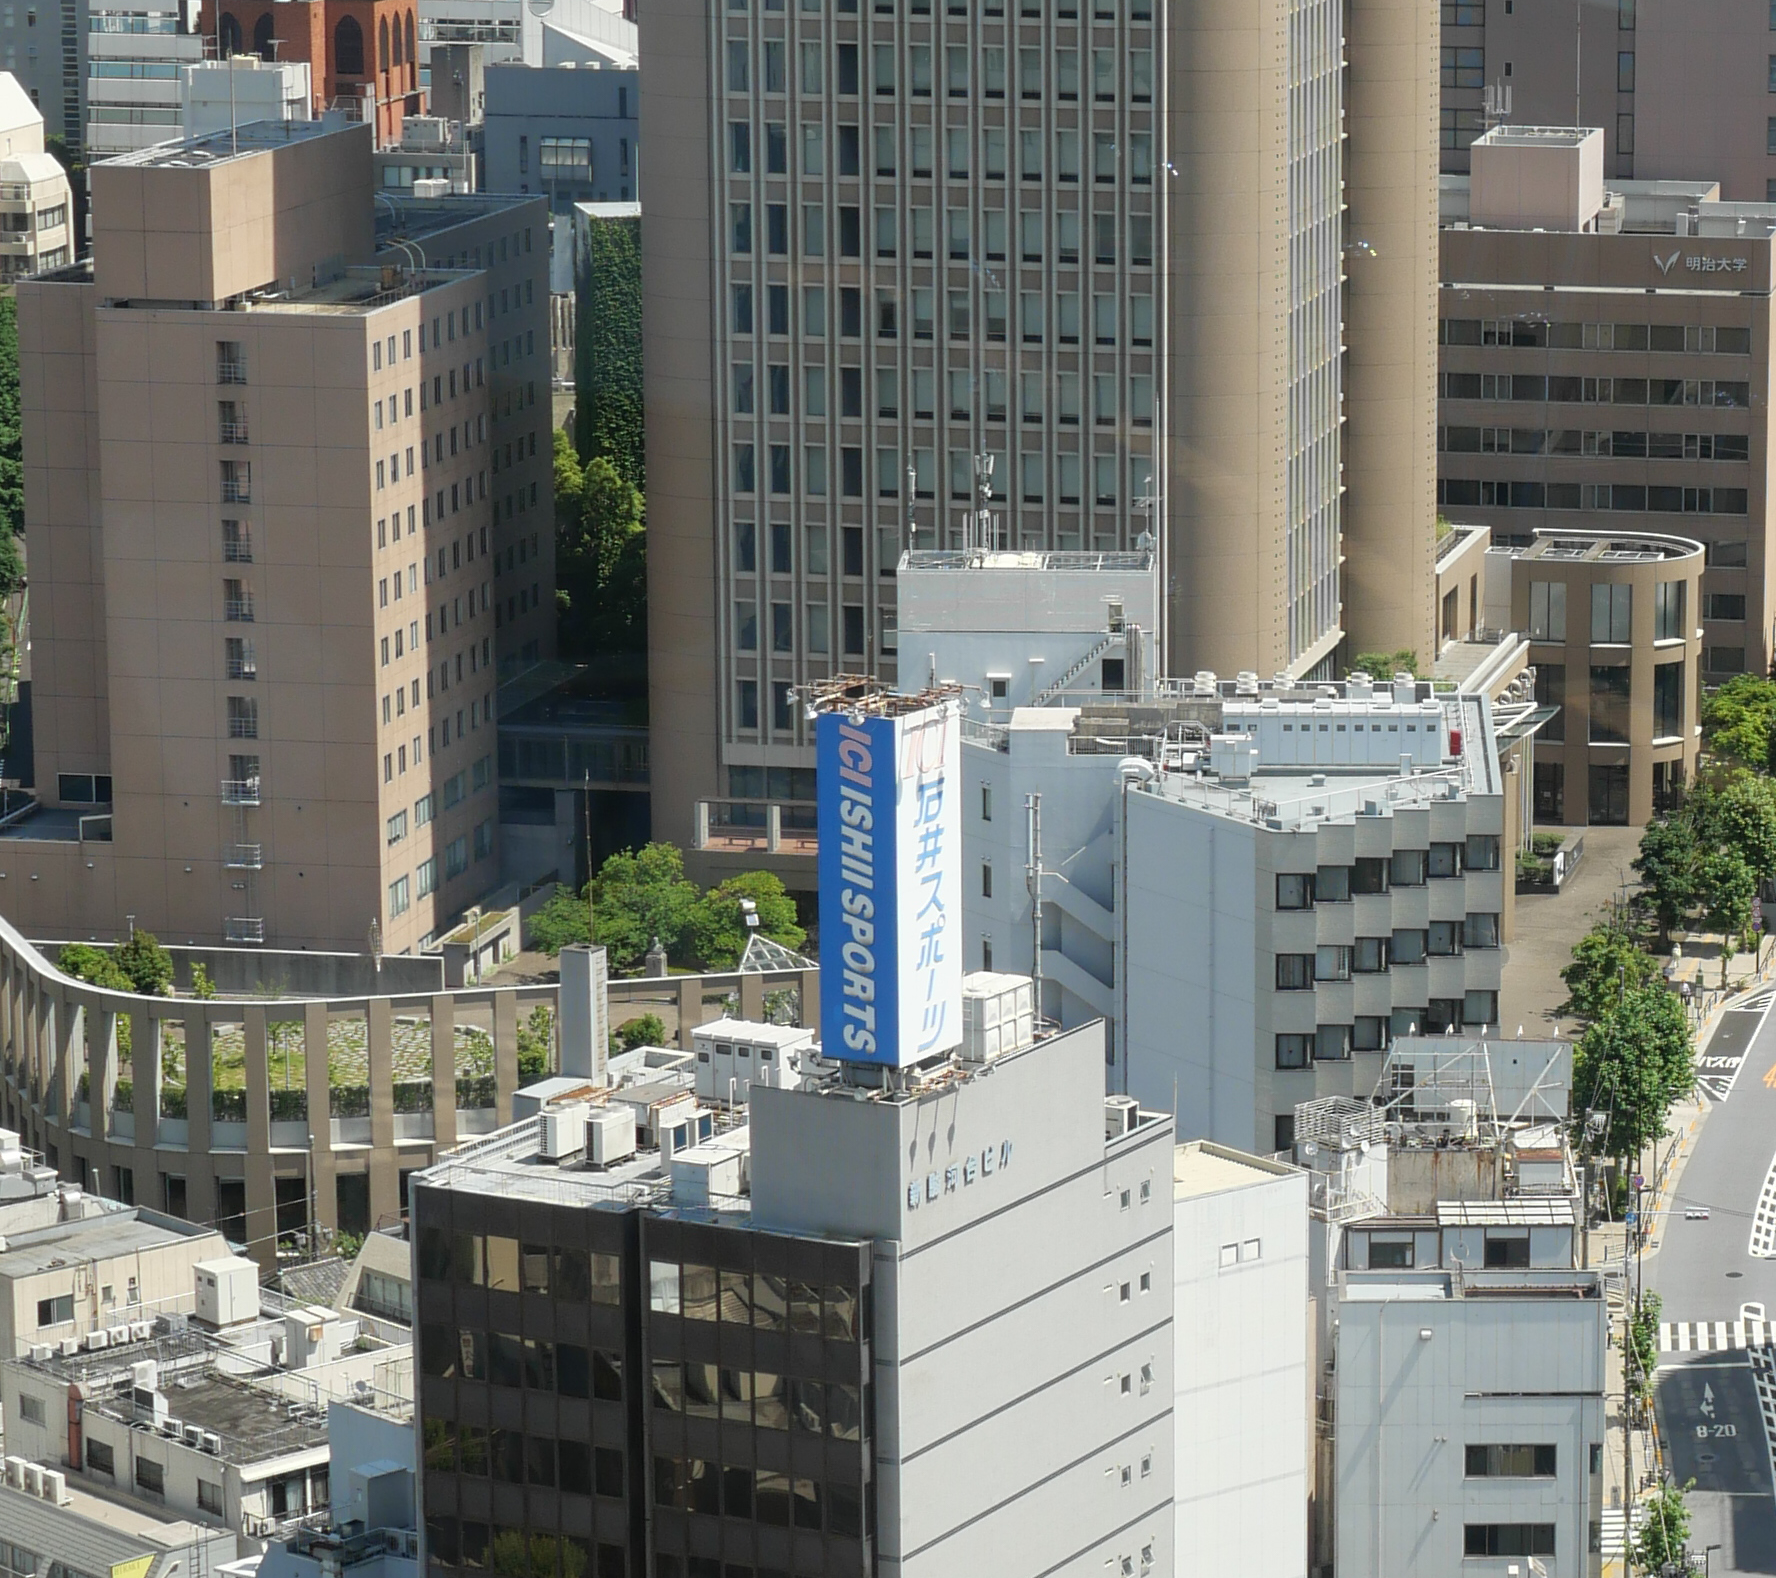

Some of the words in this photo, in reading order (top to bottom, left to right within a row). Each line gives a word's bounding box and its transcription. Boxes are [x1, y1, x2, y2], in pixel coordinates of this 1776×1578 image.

[1685, 256, 1747, 272] 明治大学
[840, 788, 874, 890] ISHII
[914, 779, 947, 1053] 石井スポーツ
[841, 890, 877, 1054] SPORTS
[1696, 1423, 1737, 1438] 8-20
